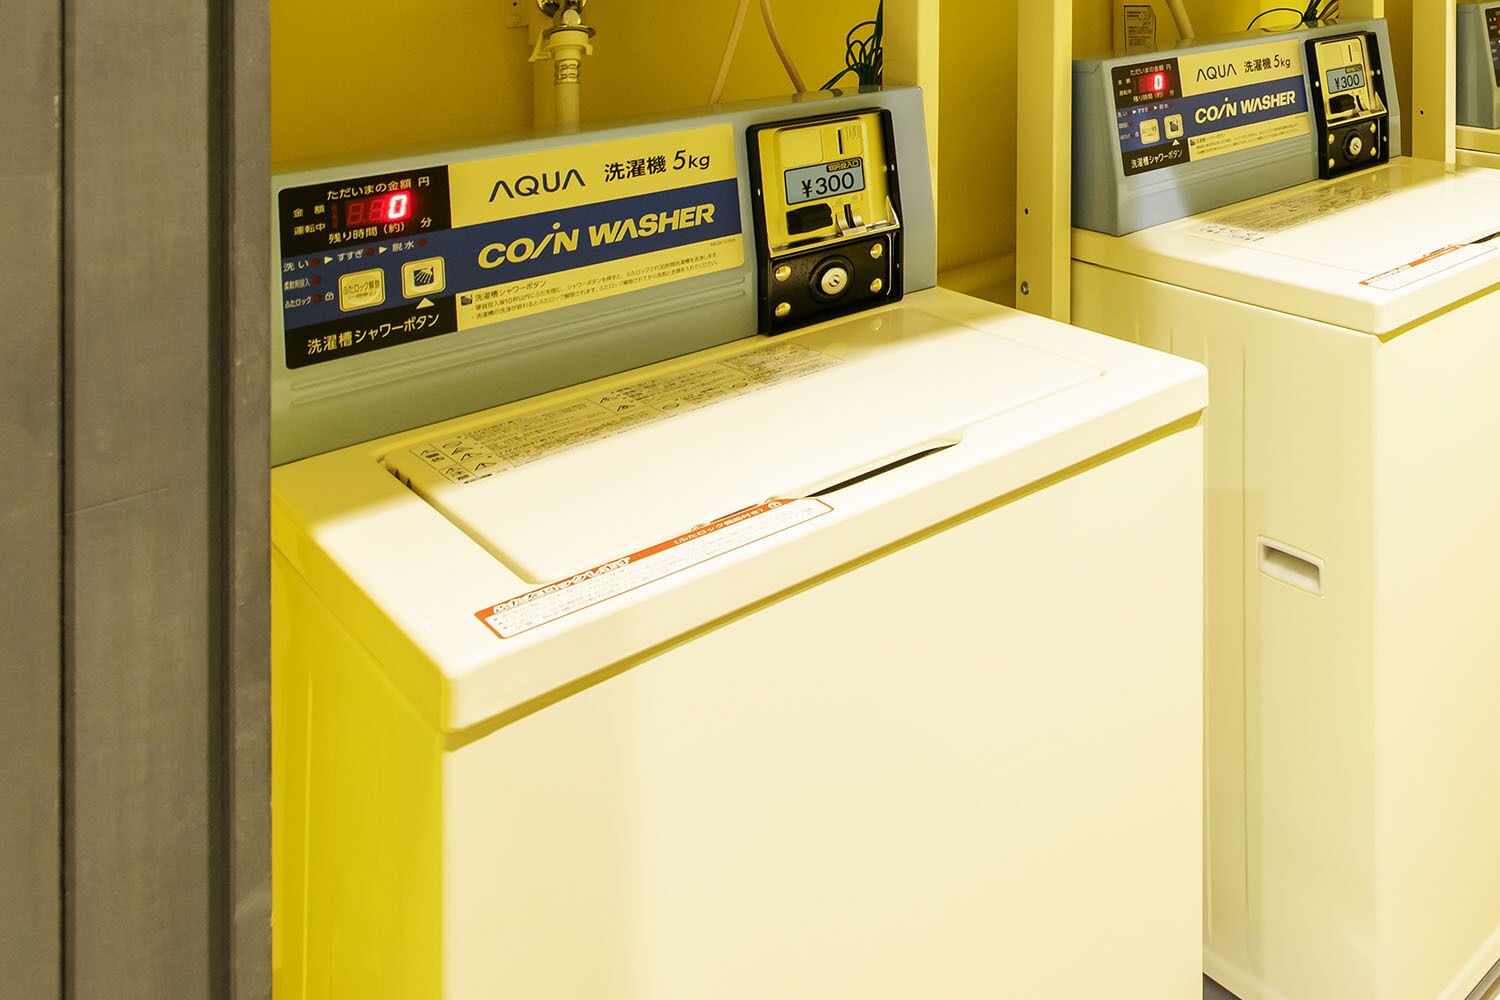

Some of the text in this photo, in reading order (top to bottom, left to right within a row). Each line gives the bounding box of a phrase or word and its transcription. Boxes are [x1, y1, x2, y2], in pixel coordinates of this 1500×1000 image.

[1196, 54, 1291, 83] AQUA 洗濯機 5kg
[1333, 73, 1360, 89] ¥300
[1240, 90, 1296, 115] WASHER
[327, 176, 430, 201] ただいまの金額 円
[488, 149, 711, 203] AQUA 洗濯機 5kg
[801, 172, 855, 198] ¥300
[420, 217, 432, 229] 分
[588, 203, 716, 247] WASHER
[307, 313, 440, 355] 洗濯槽シャワーボタン
